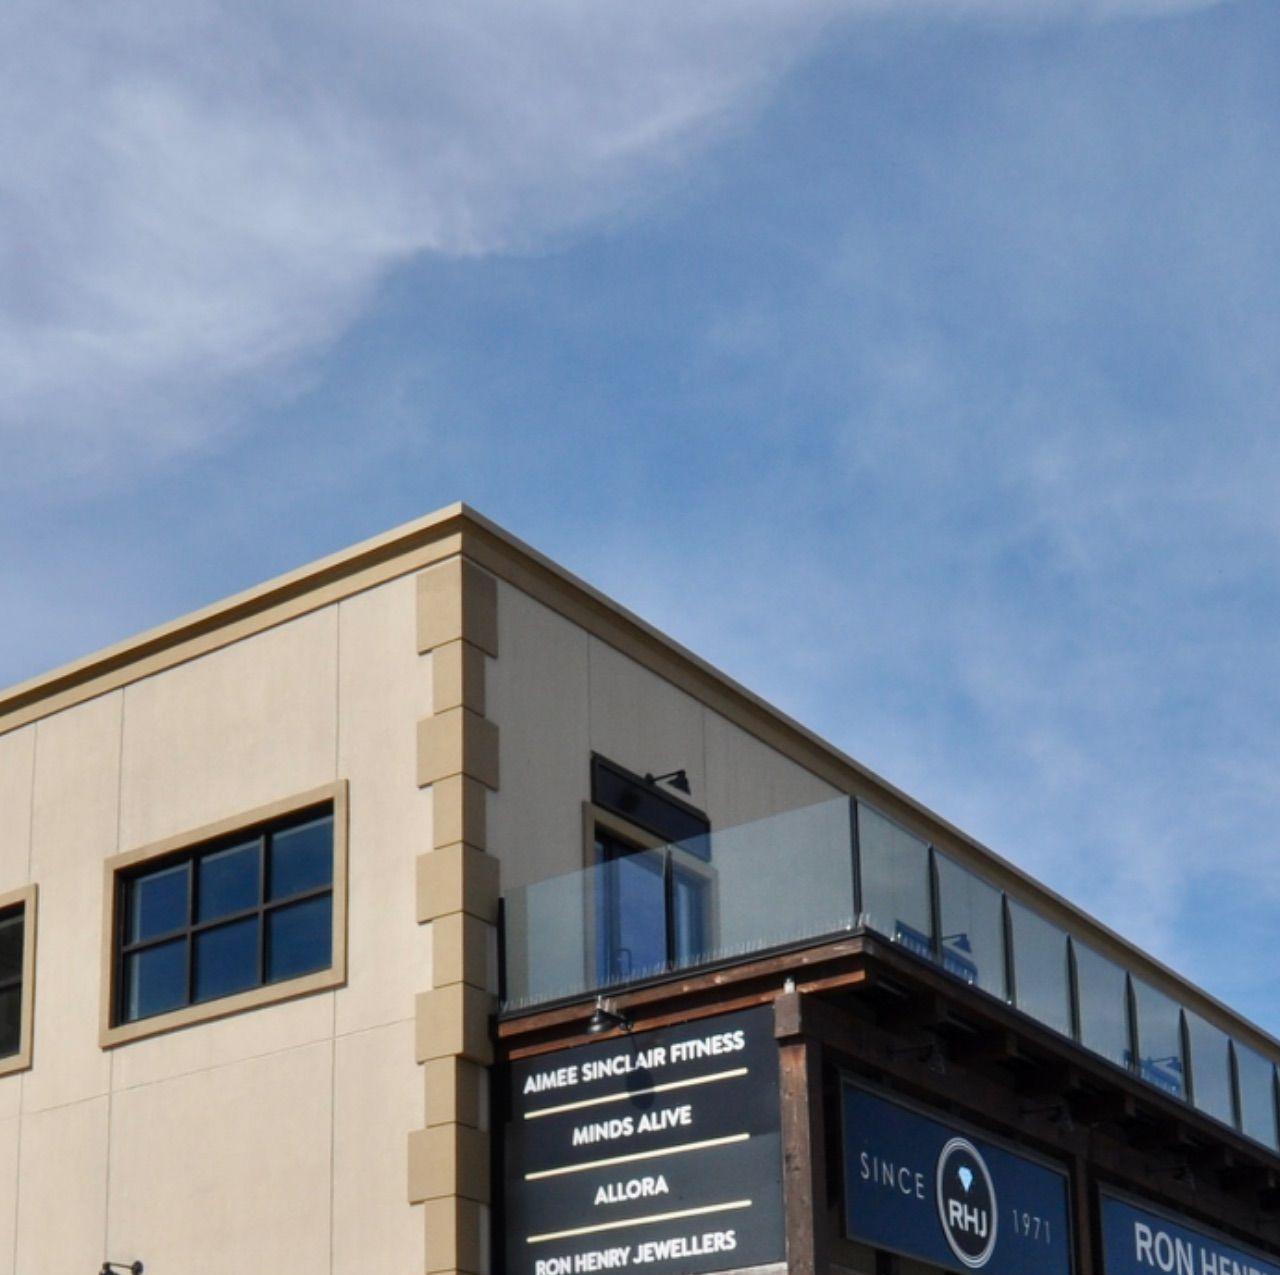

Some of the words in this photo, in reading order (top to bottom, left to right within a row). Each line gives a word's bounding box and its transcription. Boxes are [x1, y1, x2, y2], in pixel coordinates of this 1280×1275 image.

[523, 1065, 579, 1094] AIMEE
[582, 1047, 666, 1081] SINCLAIR
[670, 1030, 746, 1063] FITNESS
[572, 1116, 635, 1146] MINDS
[637, 1104, 693, 1133] ALIVE
[594, 1174, 669, 1205] ALLORA
[860, 1151, 925, 1199] SINCE
[1012, 1209, 1051, 1244] 1971
[948, 1198, 987, 1238] RHJ
[575, 1245, 631, 1273] HENRY
[632, 1230, 737, 1264] JEWELLERS
